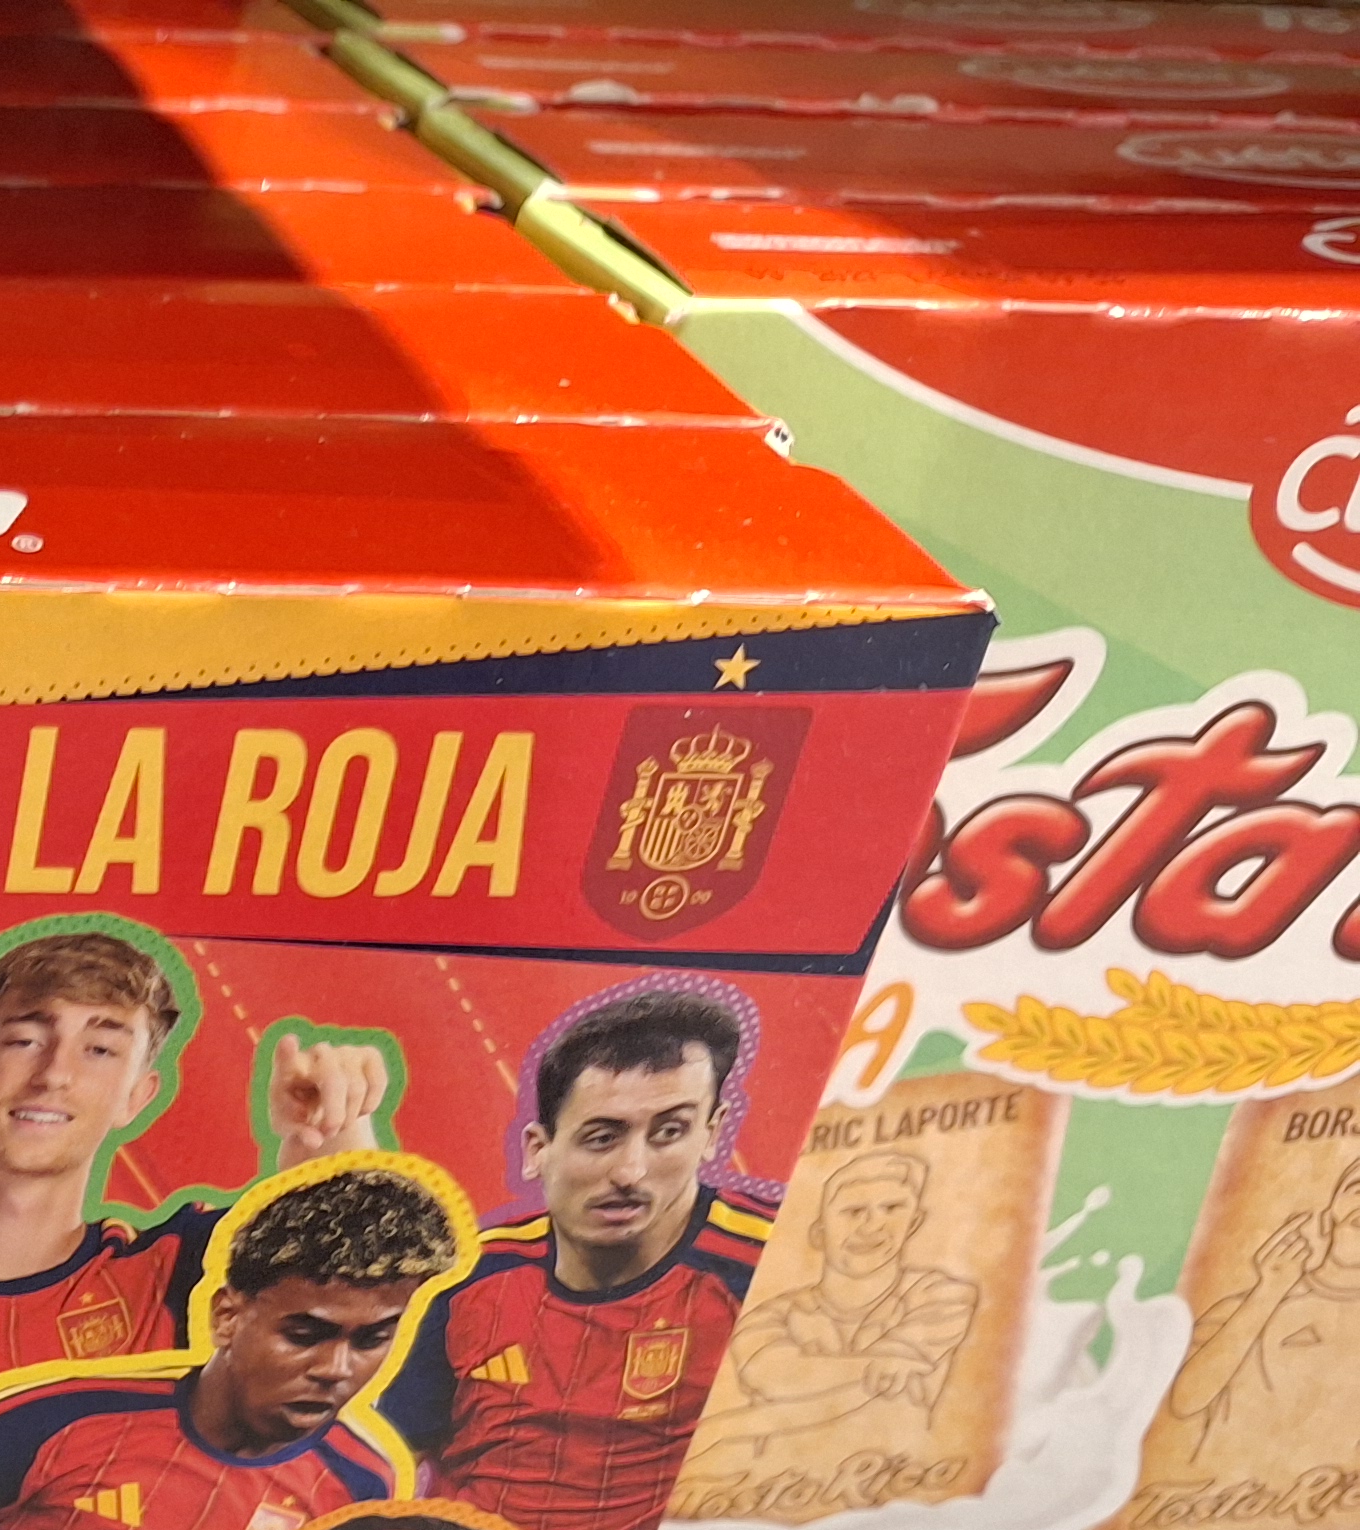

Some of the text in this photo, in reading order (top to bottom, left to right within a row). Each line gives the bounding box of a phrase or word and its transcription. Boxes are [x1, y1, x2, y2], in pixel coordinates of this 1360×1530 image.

[2, 726, 536, 898] LA ROJA
[900, 656, 1360, 959] sta
[872, 1090, 1023, 1144] LAPORTE
